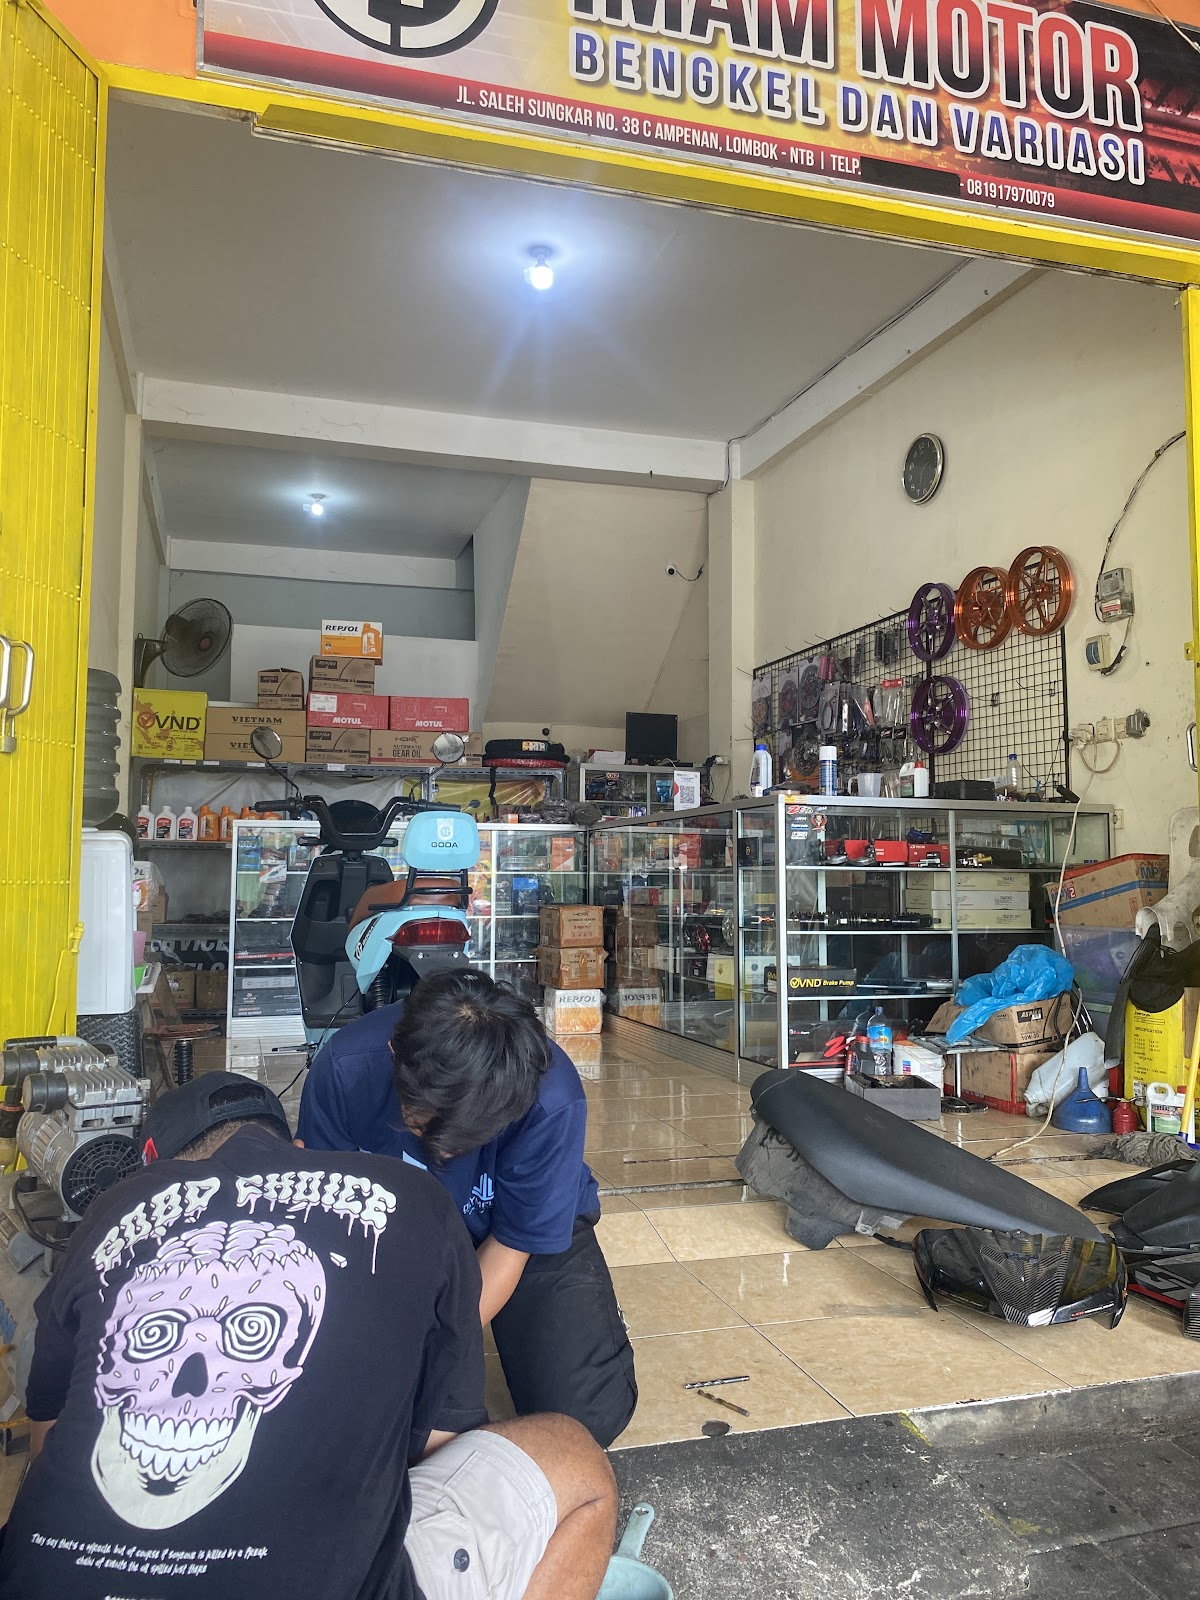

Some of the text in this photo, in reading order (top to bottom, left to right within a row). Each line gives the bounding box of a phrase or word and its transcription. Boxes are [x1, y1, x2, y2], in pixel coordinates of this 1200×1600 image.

[568, 0, 1144, 132] AM MOTOR
[569, 26, 1146, 185] BENGKEL DAN VARIASI
[456, 85, 475, 106] JL.
[479, 89, 525, 115] SALEH
[528, 98, 593, 127] SUNGKAR
[596, 111, 618, 132] NO.
[622, 116, 639, 135] 38
[643, 120, 652, 137] C
[654, 122, 722, 153] AMPENAN,
[726, 135, 778, 161] LOMBOK
[790, 147, 815, 167] NTB
[830, 154, 862, 176] TELP.
[967, 179, 1055, 208] 081917970079
[325, 624, 359, 633] REPSOL
[155, 714, 201, 731] VND
[232, 716, 283, 724] VIETNAM
[332, 716, 362, 725] MOTUL
[415, 720, 443, 728] MOTUL
[392, 749, 422, 758] GEAR OIL
[559, 995, 597, 1003] REPSOL
[235, 1170, 397, 1236] CHOICE
[46, 1536, 58, 1549] say
[113, 1544, 127, 1556] but
[127, 1546, 137, 1558] of
[95, 1556, 106, 1569] of
